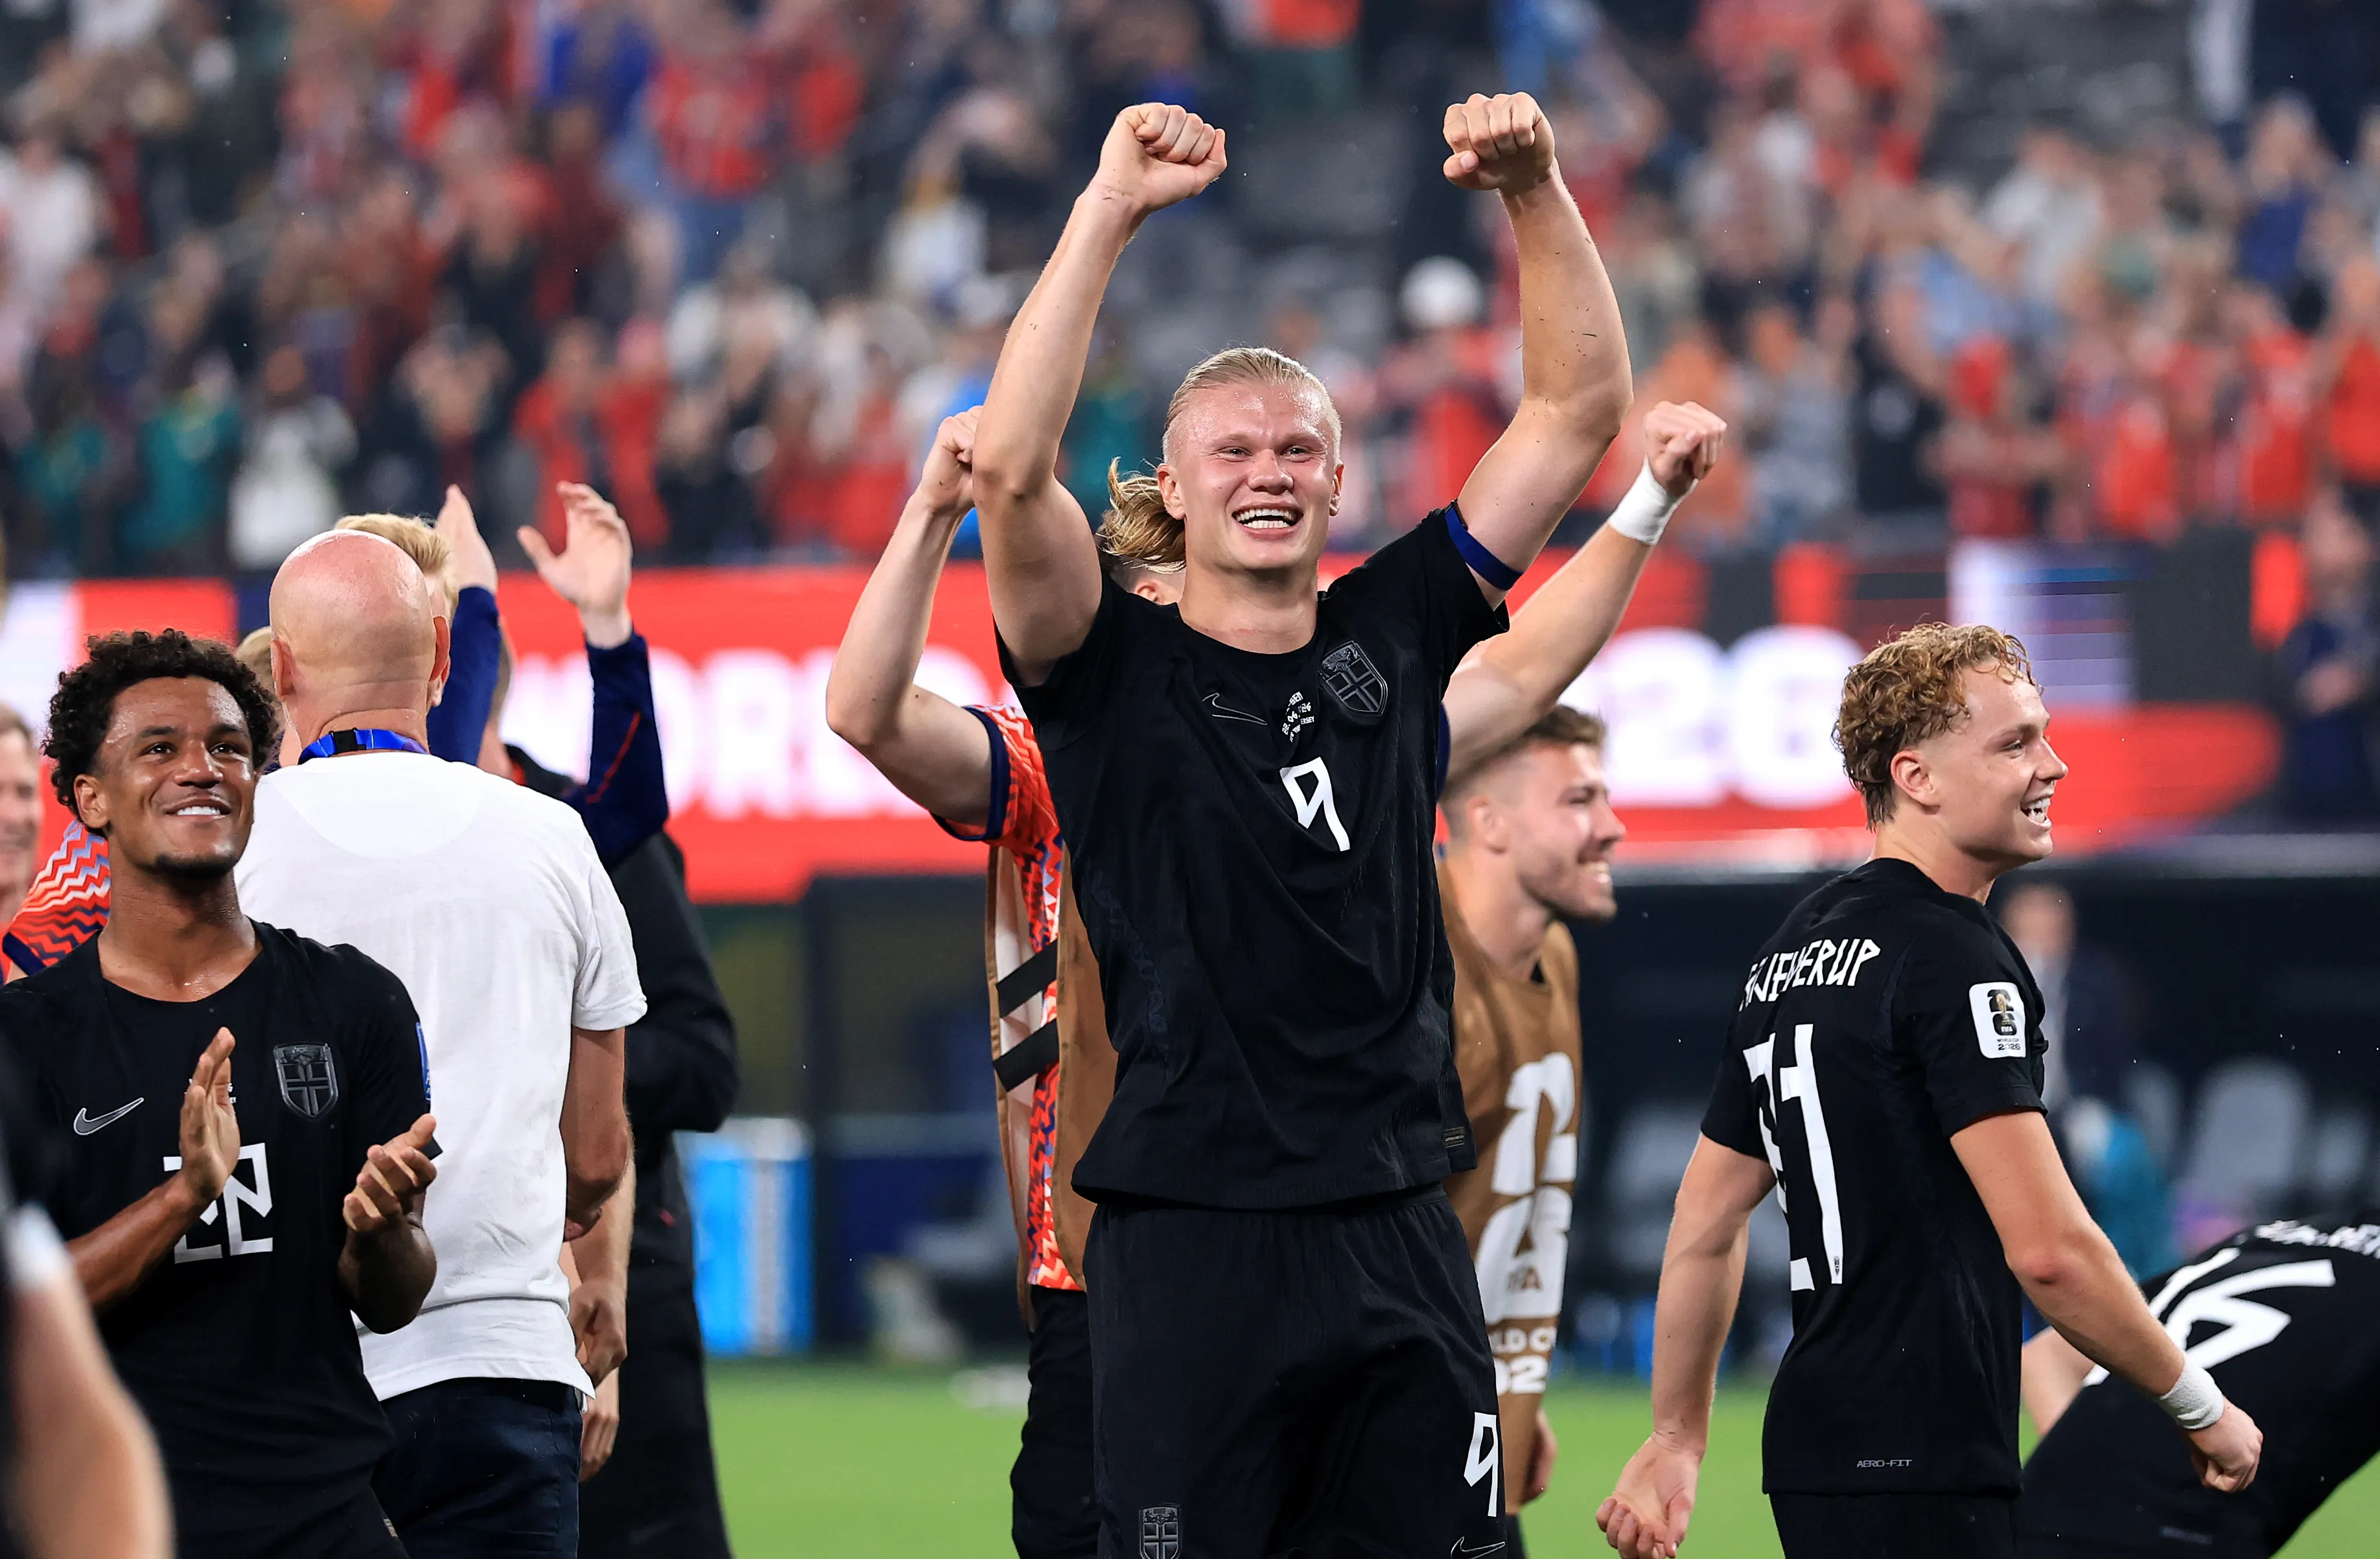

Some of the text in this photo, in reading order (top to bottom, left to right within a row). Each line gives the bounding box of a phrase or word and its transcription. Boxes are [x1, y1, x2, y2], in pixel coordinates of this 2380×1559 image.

[1279, 756, 1350, 852] 9
[1464, 1412, 1498, 1518] 9
[1857, 1459, 1913, 1468] AERO-FIT
